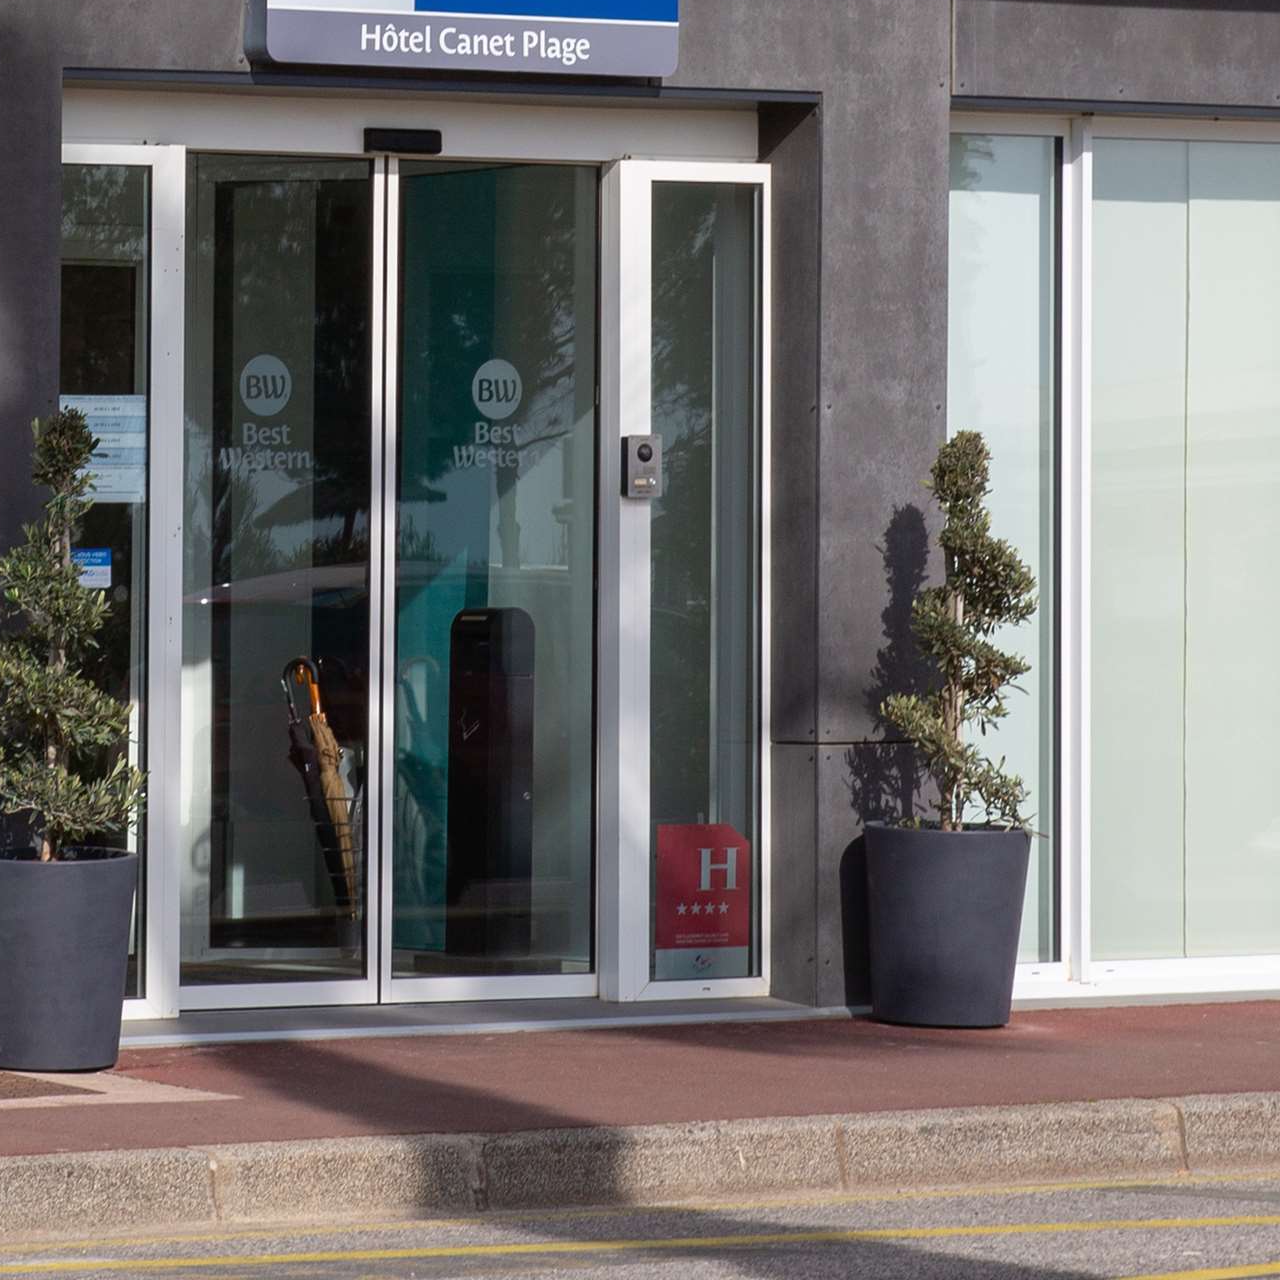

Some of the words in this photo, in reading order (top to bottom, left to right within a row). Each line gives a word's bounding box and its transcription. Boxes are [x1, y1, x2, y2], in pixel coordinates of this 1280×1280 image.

[360, 23, 433, 55] Hôtel
[439, 26, 515, 57] Canet
[523, 30, 591, 65] Plage
[246, 375, 287, 400] BW
[478, 378, 517, 404] BW
[242, 422, 292, 446] Best
[474, 421, 521, 447] Best
[219, 447, 312, 471] Western
[696, 847, 741, 891] H
